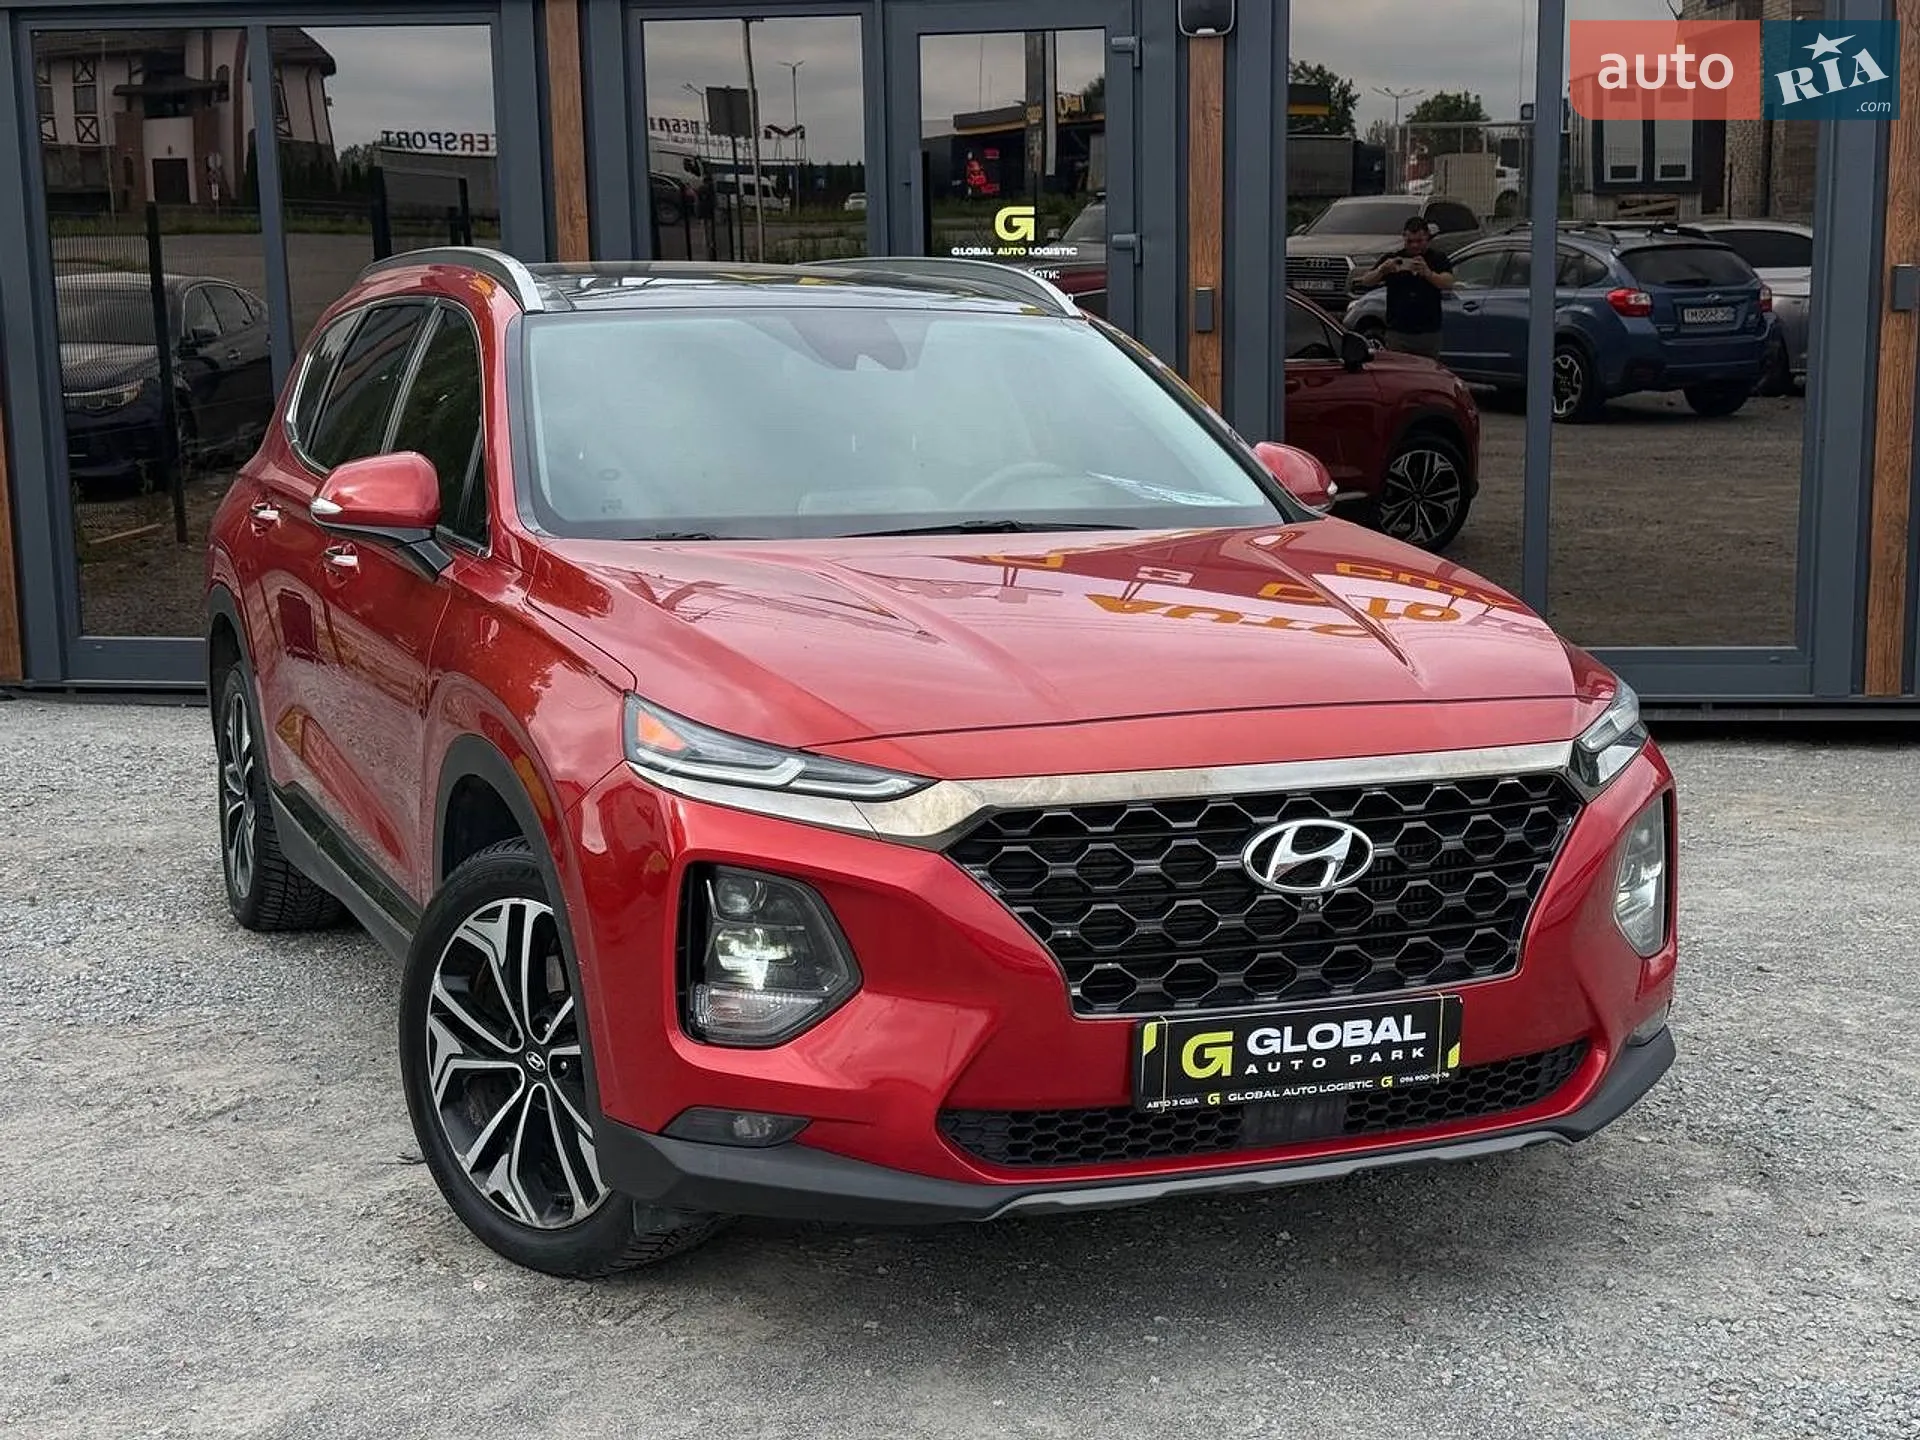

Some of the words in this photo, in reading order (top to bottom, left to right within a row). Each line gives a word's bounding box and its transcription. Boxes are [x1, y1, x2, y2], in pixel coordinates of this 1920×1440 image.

[951, 247, 995, 256] GLOBAL
[996, 247, 1027, 256] AUTO
[1028, 247, 1078, 256] LOGISTIC
[1246, 1014, 1427, 1057] GLOBAL
[1244, 1057, 1327, 1075] AUTO
[1350, 1046, 1427, 1065] PARK
[1228, 1090, 1280, 1102] GLOBAL
[1282, 1084, 1318, 1097] AUTO
[1319, 1079, 1374, 1093] LOGISTIC
